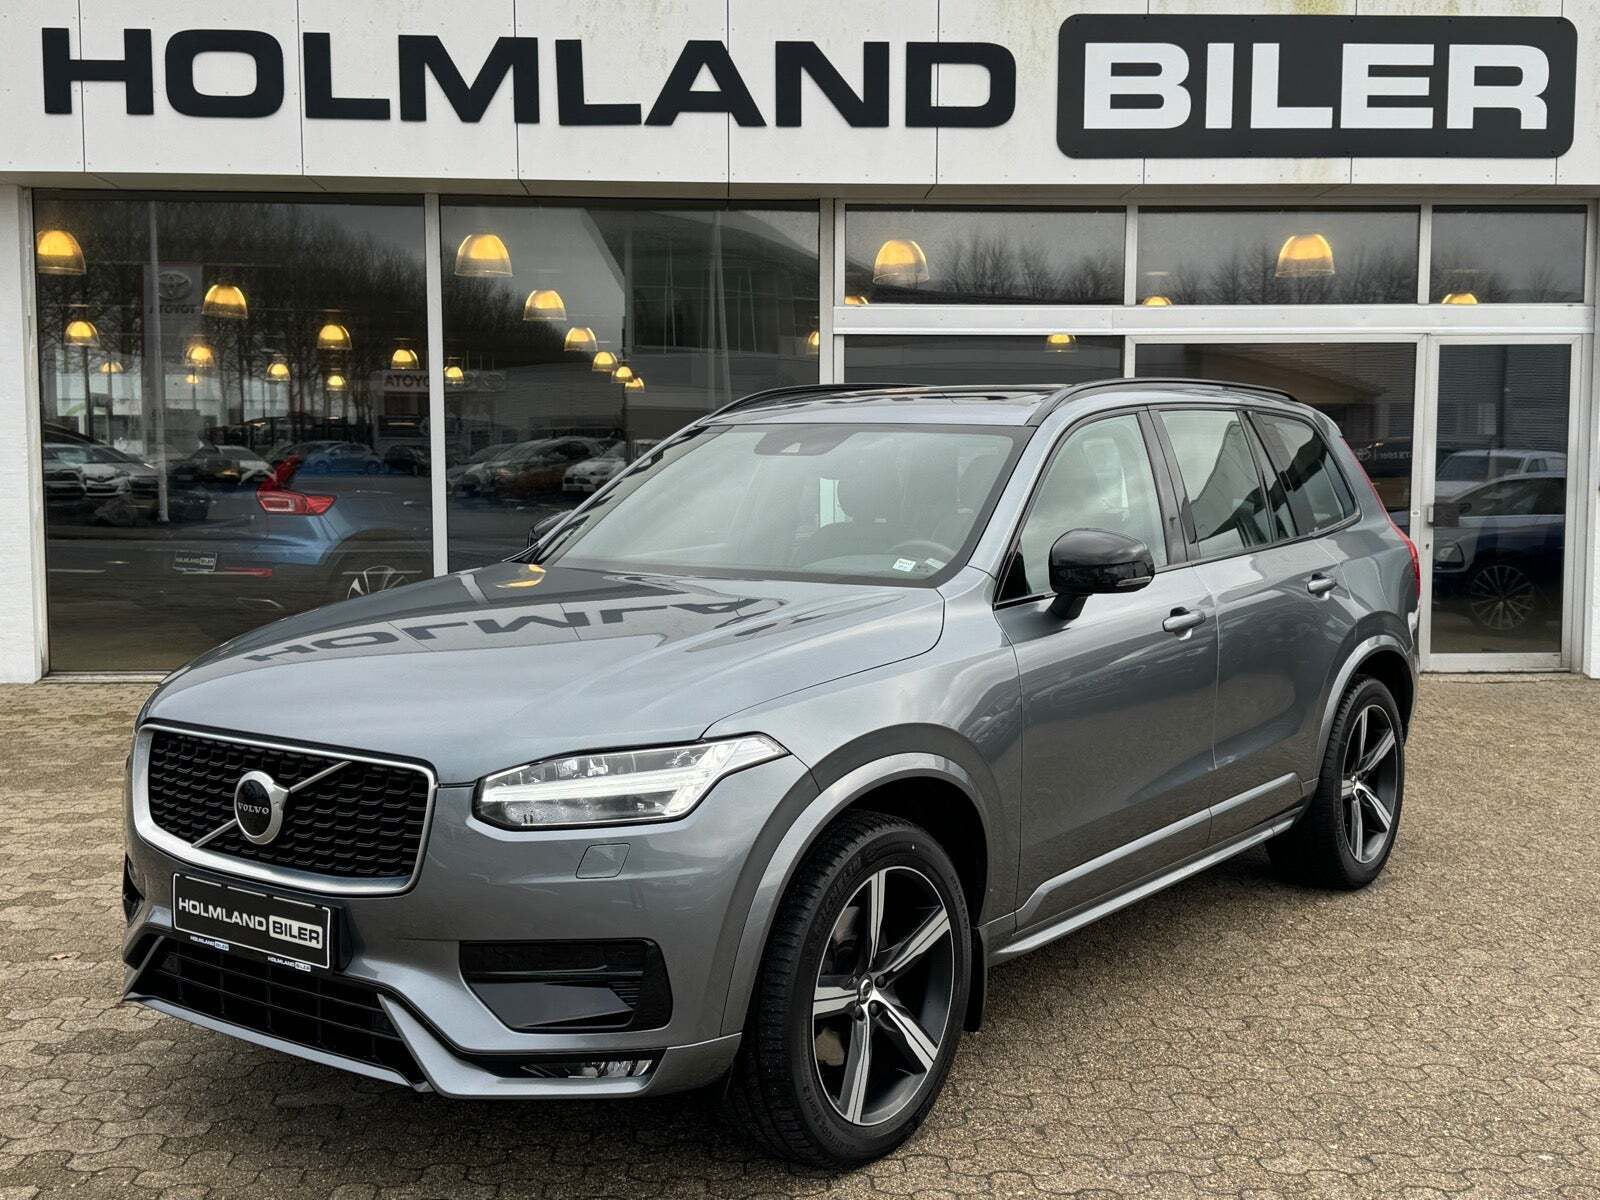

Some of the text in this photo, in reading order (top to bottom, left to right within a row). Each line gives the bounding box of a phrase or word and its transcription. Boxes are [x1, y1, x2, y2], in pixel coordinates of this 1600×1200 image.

[42, 28, 1549, 132] HOLMLAND BILER
[238, 802, 269, 815] VOLVO
[178, 897, 320, 945] HOLMLAND BILER
